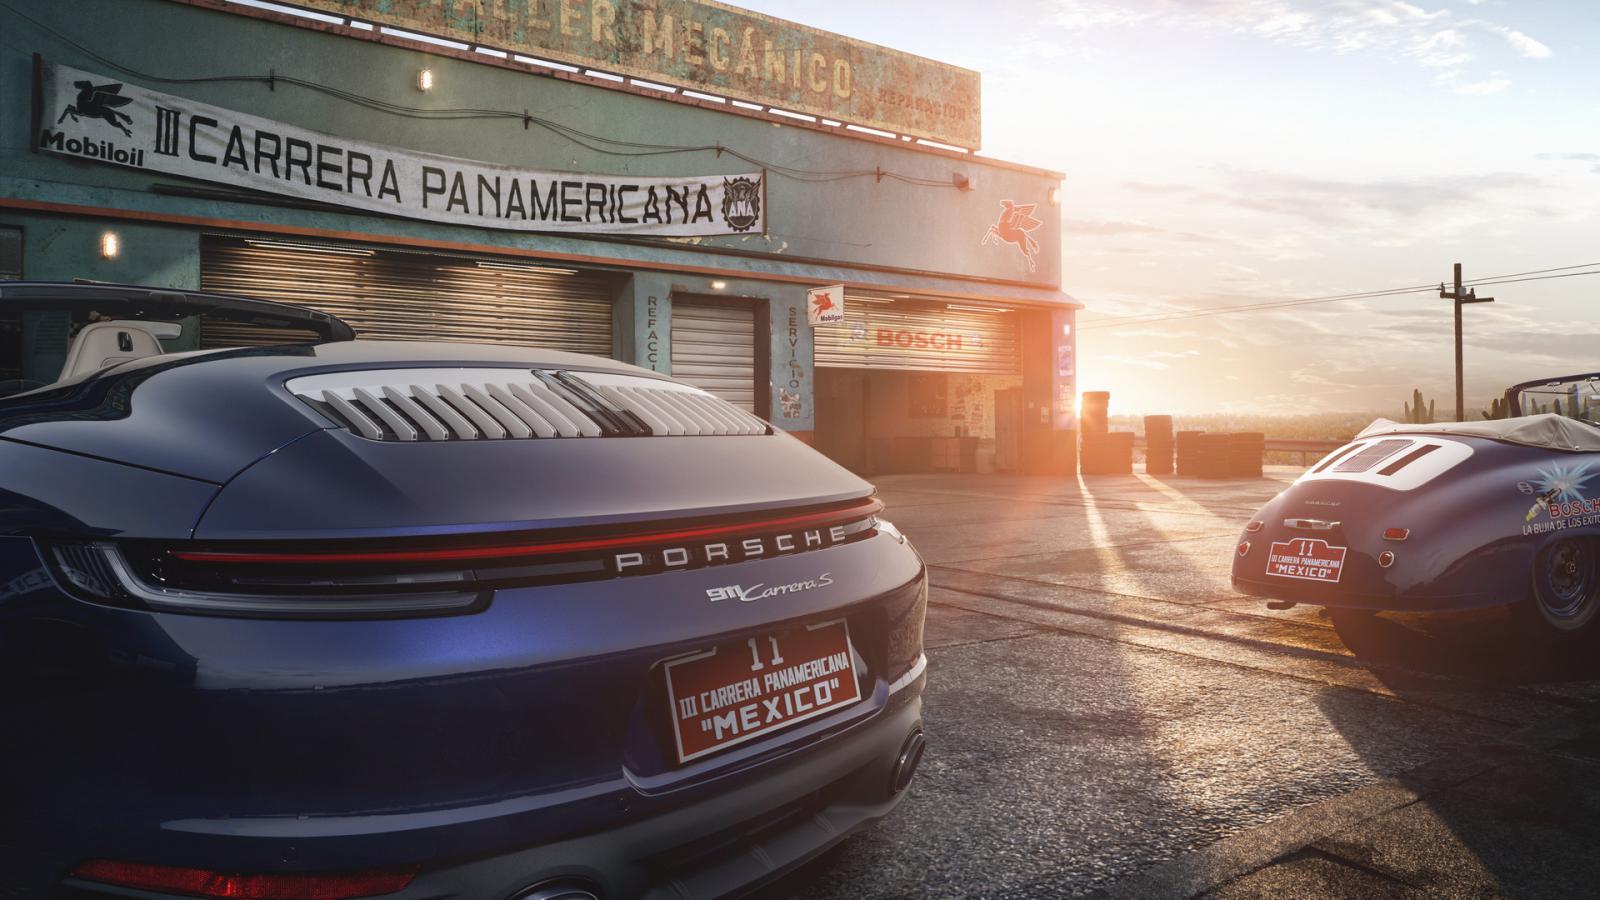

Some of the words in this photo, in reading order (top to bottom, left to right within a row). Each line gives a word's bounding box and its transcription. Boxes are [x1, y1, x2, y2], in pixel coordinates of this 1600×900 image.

[642, 10, 851, 98] MECÁNICO
[40, 129, 144, 167] Mobiloil
[153, 105, 181, 157] III
[189, 115, 402, 203] CARRERA
[422, 166, 714, 224] PANAMERICANA
[728, 200, 755, 217] ANA
[789, 307, 800, 388] SERVICIO
[877, 328, 962, 351] BOSCH
[1522, 524, 1533, 536] LA
[1556, 519, 1567, 530] DE
[1568, 516, 1582, 528] LOS
[616, 525, 846, 572] PORSCHE
[1278, 555, 1300, 565] CARRERA
[1300, 557, 1340, 569] PANAMERICANA
[1298, 541, 1314, 556] 11
[1275, 563, 1332, 578] "MEXICO"
[748, 636, 784, 672] 11
[679, 696, 698, 720] III
[700, 678, 761, 713] CARRERA
[764, 651, 850, 694] PANAMERICANA
[701, 677, 840, 740] "MEXICO"
